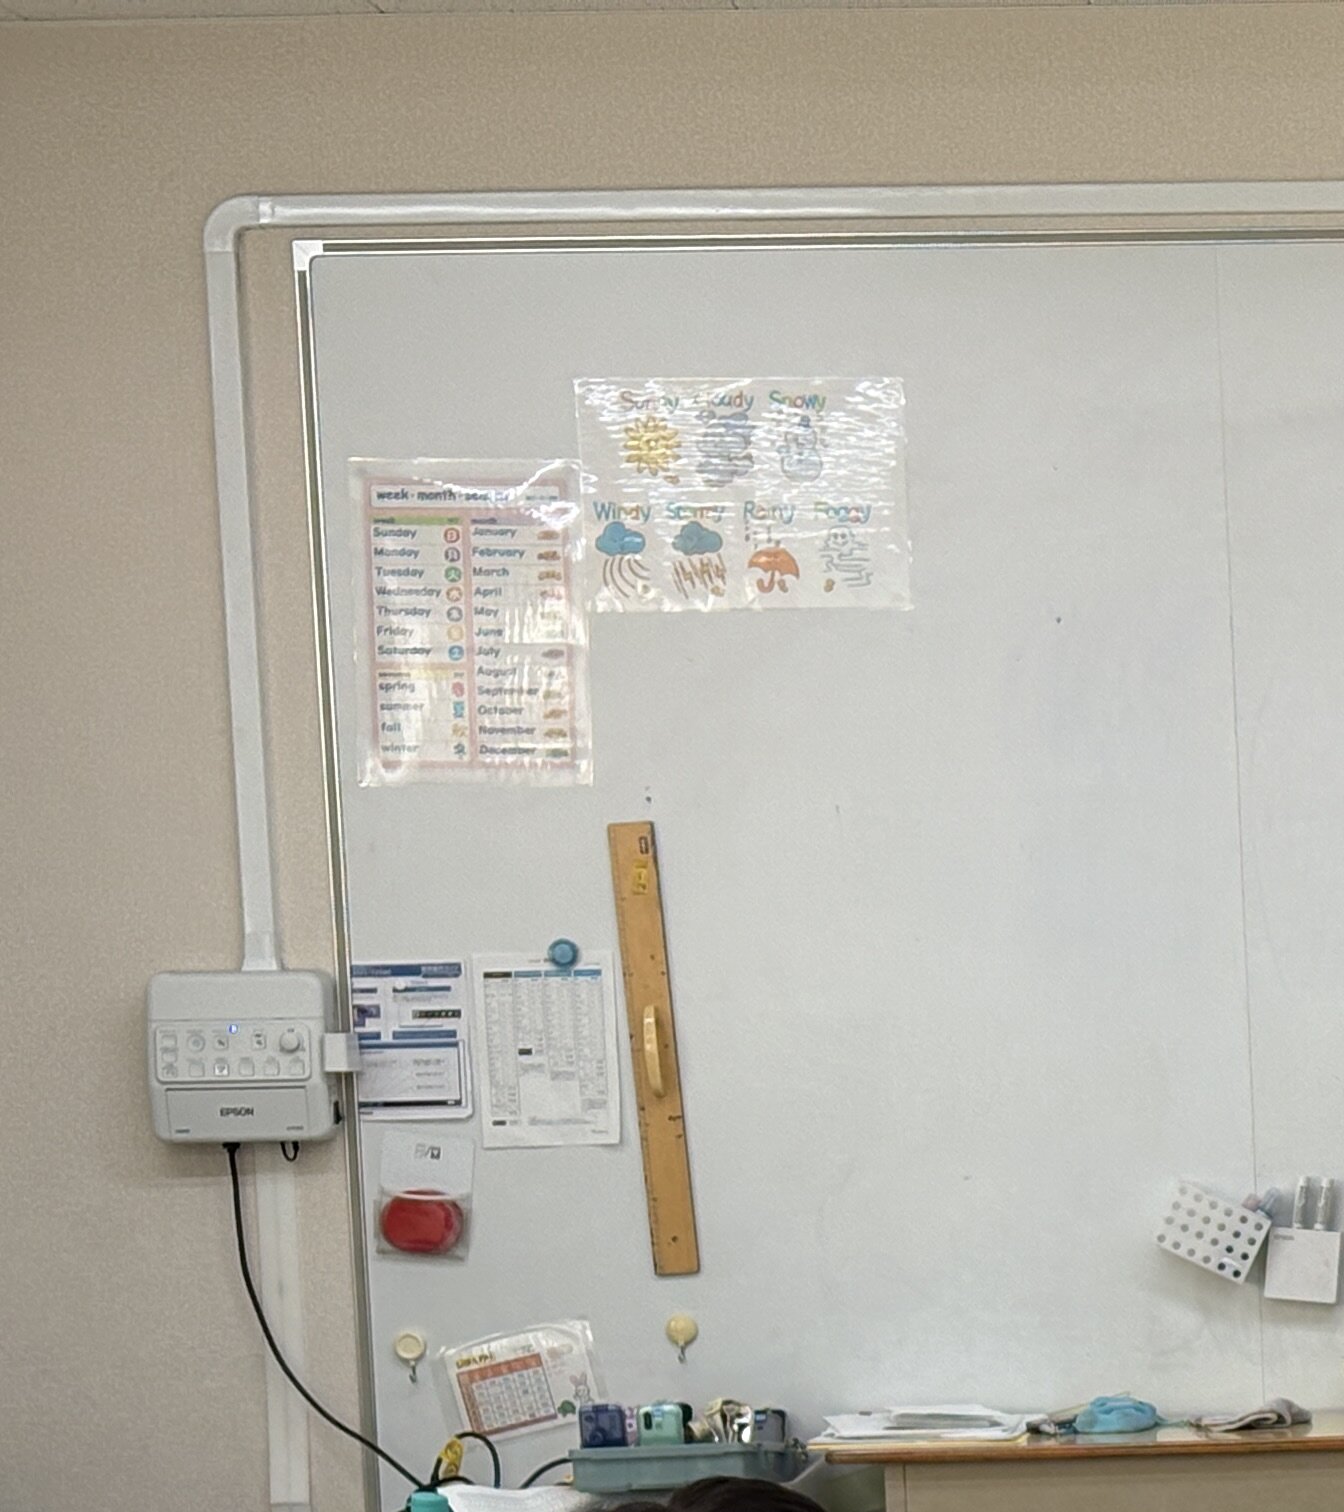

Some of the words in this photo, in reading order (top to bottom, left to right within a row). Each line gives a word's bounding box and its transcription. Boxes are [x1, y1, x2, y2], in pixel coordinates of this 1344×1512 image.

[592, 501, 652, 524] Windy
[373, 527, 417, 539] Sunday
[472, 547, 525, 559] February
[375, 567, 425, 579] Tuesday
[472, 567, 510, 577] March
[474, 586, 502, 598] April
